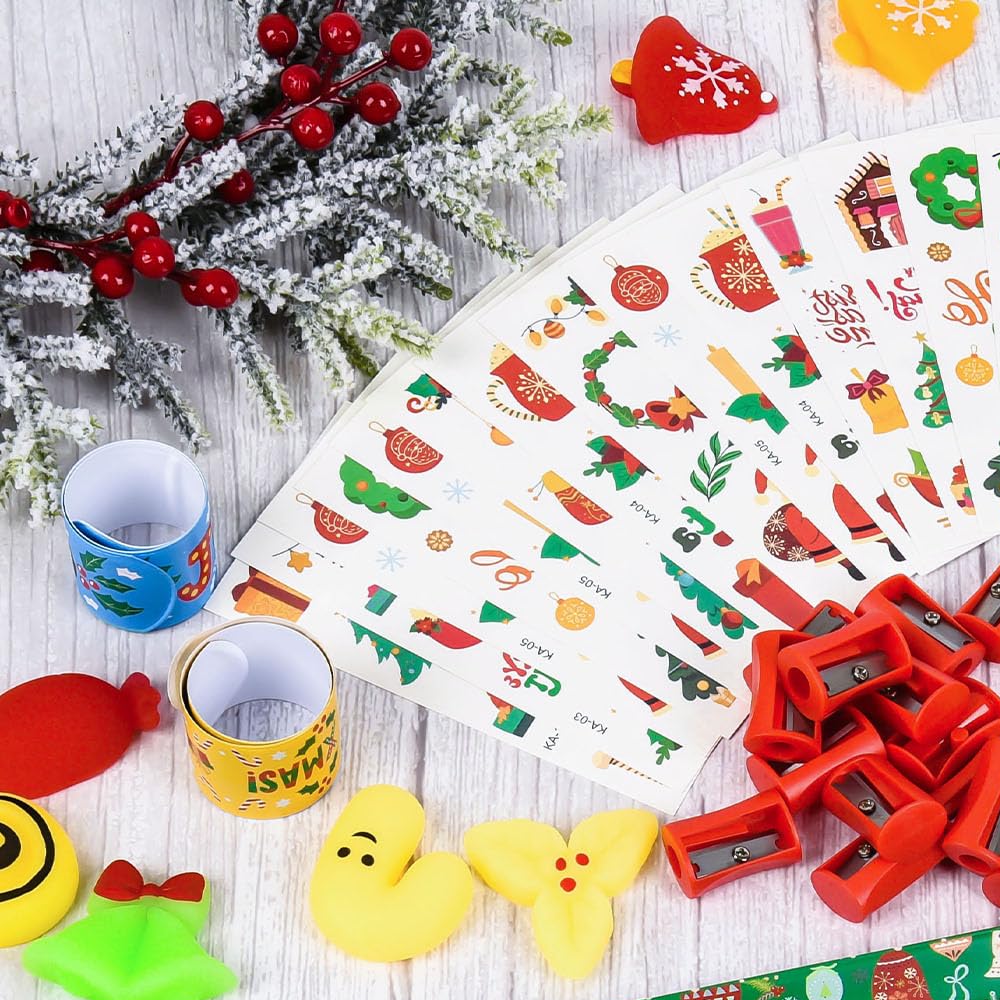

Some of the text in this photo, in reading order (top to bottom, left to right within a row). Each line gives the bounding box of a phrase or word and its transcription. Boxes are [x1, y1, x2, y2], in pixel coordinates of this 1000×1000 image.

[754, 439, 783, 466] KA-05
[578, 575, 612, 599] KA-05
[519, 637, 554, 660] KA-05
[573, 712, 608, 735] KA-03
